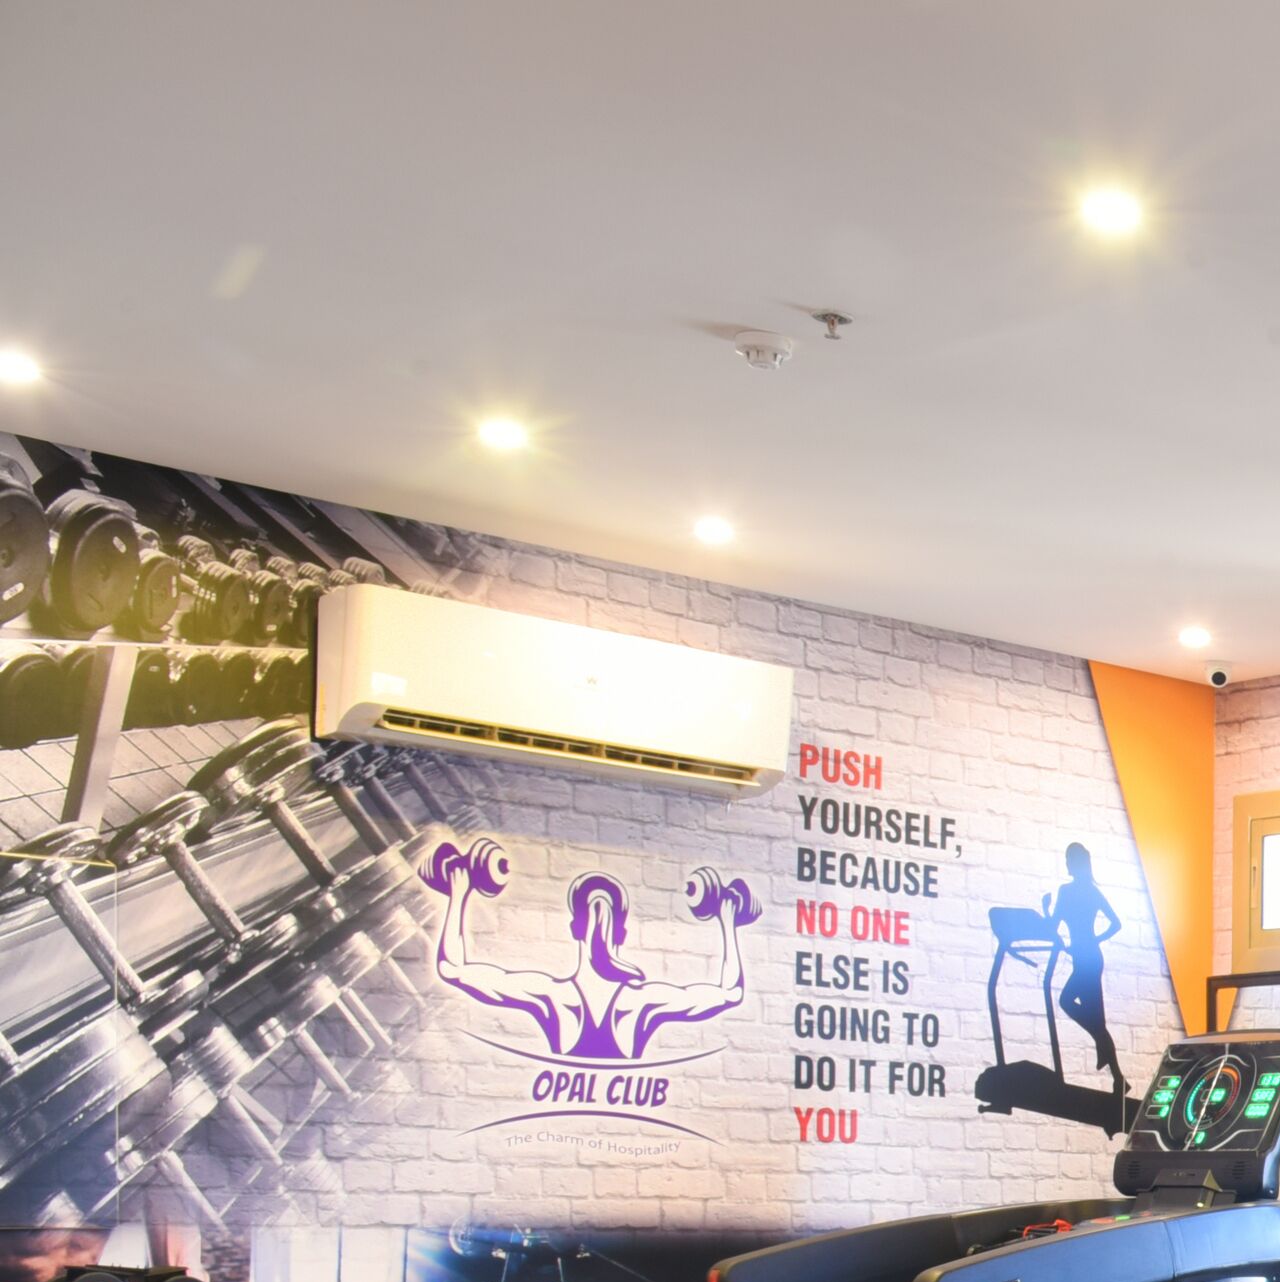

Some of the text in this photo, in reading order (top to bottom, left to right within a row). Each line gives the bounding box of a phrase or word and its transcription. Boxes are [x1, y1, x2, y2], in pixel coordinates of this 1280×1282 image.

[799, 743, 883, 790] PUSH
[798, 795, 964, 859] YOURSELF,
[797, 847, 939, 899] BECAUSE
[796, 900, 910, 946] NO ONE
[795, 952, 910, 996] ELSE IS
[794, 1003, 940, 1048] GOING TO
[532, 1070, 669, 1107] OPAL CLUB
[794, 1055, 947, 1098] DO IT FOR
[505, 1131, 681, 1157] The Charm of Hospitality
[793, 1106, 858, 1144] YOU
